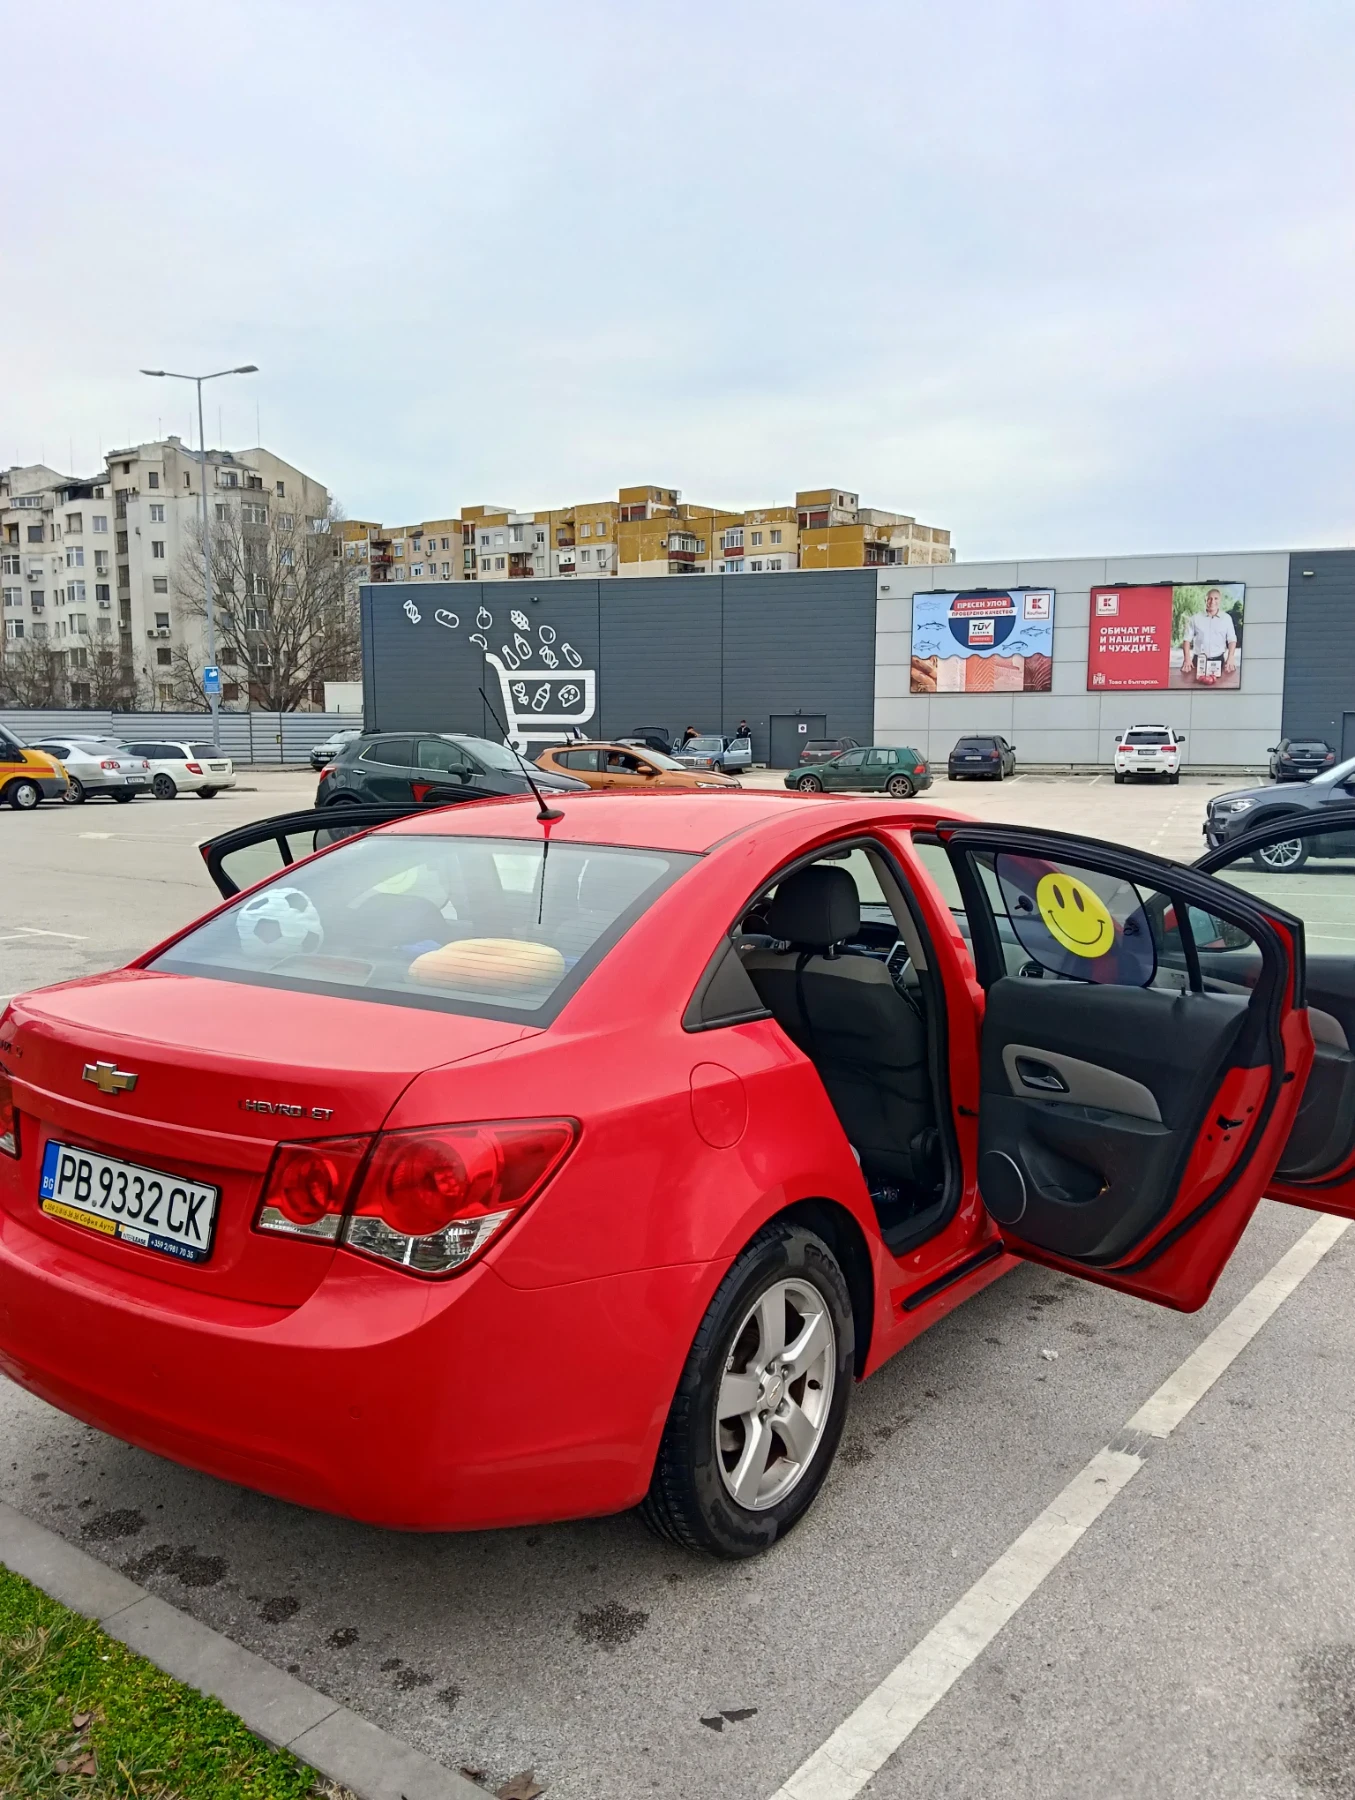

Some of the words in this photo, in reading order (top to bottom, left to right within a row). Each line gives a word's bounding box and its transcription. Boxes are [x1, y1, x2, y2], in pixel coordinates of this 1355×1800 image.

[957, 601, 985, 609] ПРЕСЕН
[986, 599, 1007, 607] УЛОВ
[1100, 626, 1140, 635] ОБИЧАТ
[1141, 626, 1157, 634] МЕ
[1099, 636, 1107, 644] И
[1108, 635, 1154, 644] НАШИТЕ,
[1099, 645, 1107, 653] И
[1108, 643, 1161, 653] ЧУЖДИТЕ.
[43, 1177, 54, 1191] BG
[79, 1213, 98, 1226] София
[98, 1221, 114, 1232] Ауто
[150, 1239, 164, 1249] +359
[179, 1247, 187, 1257] 70
